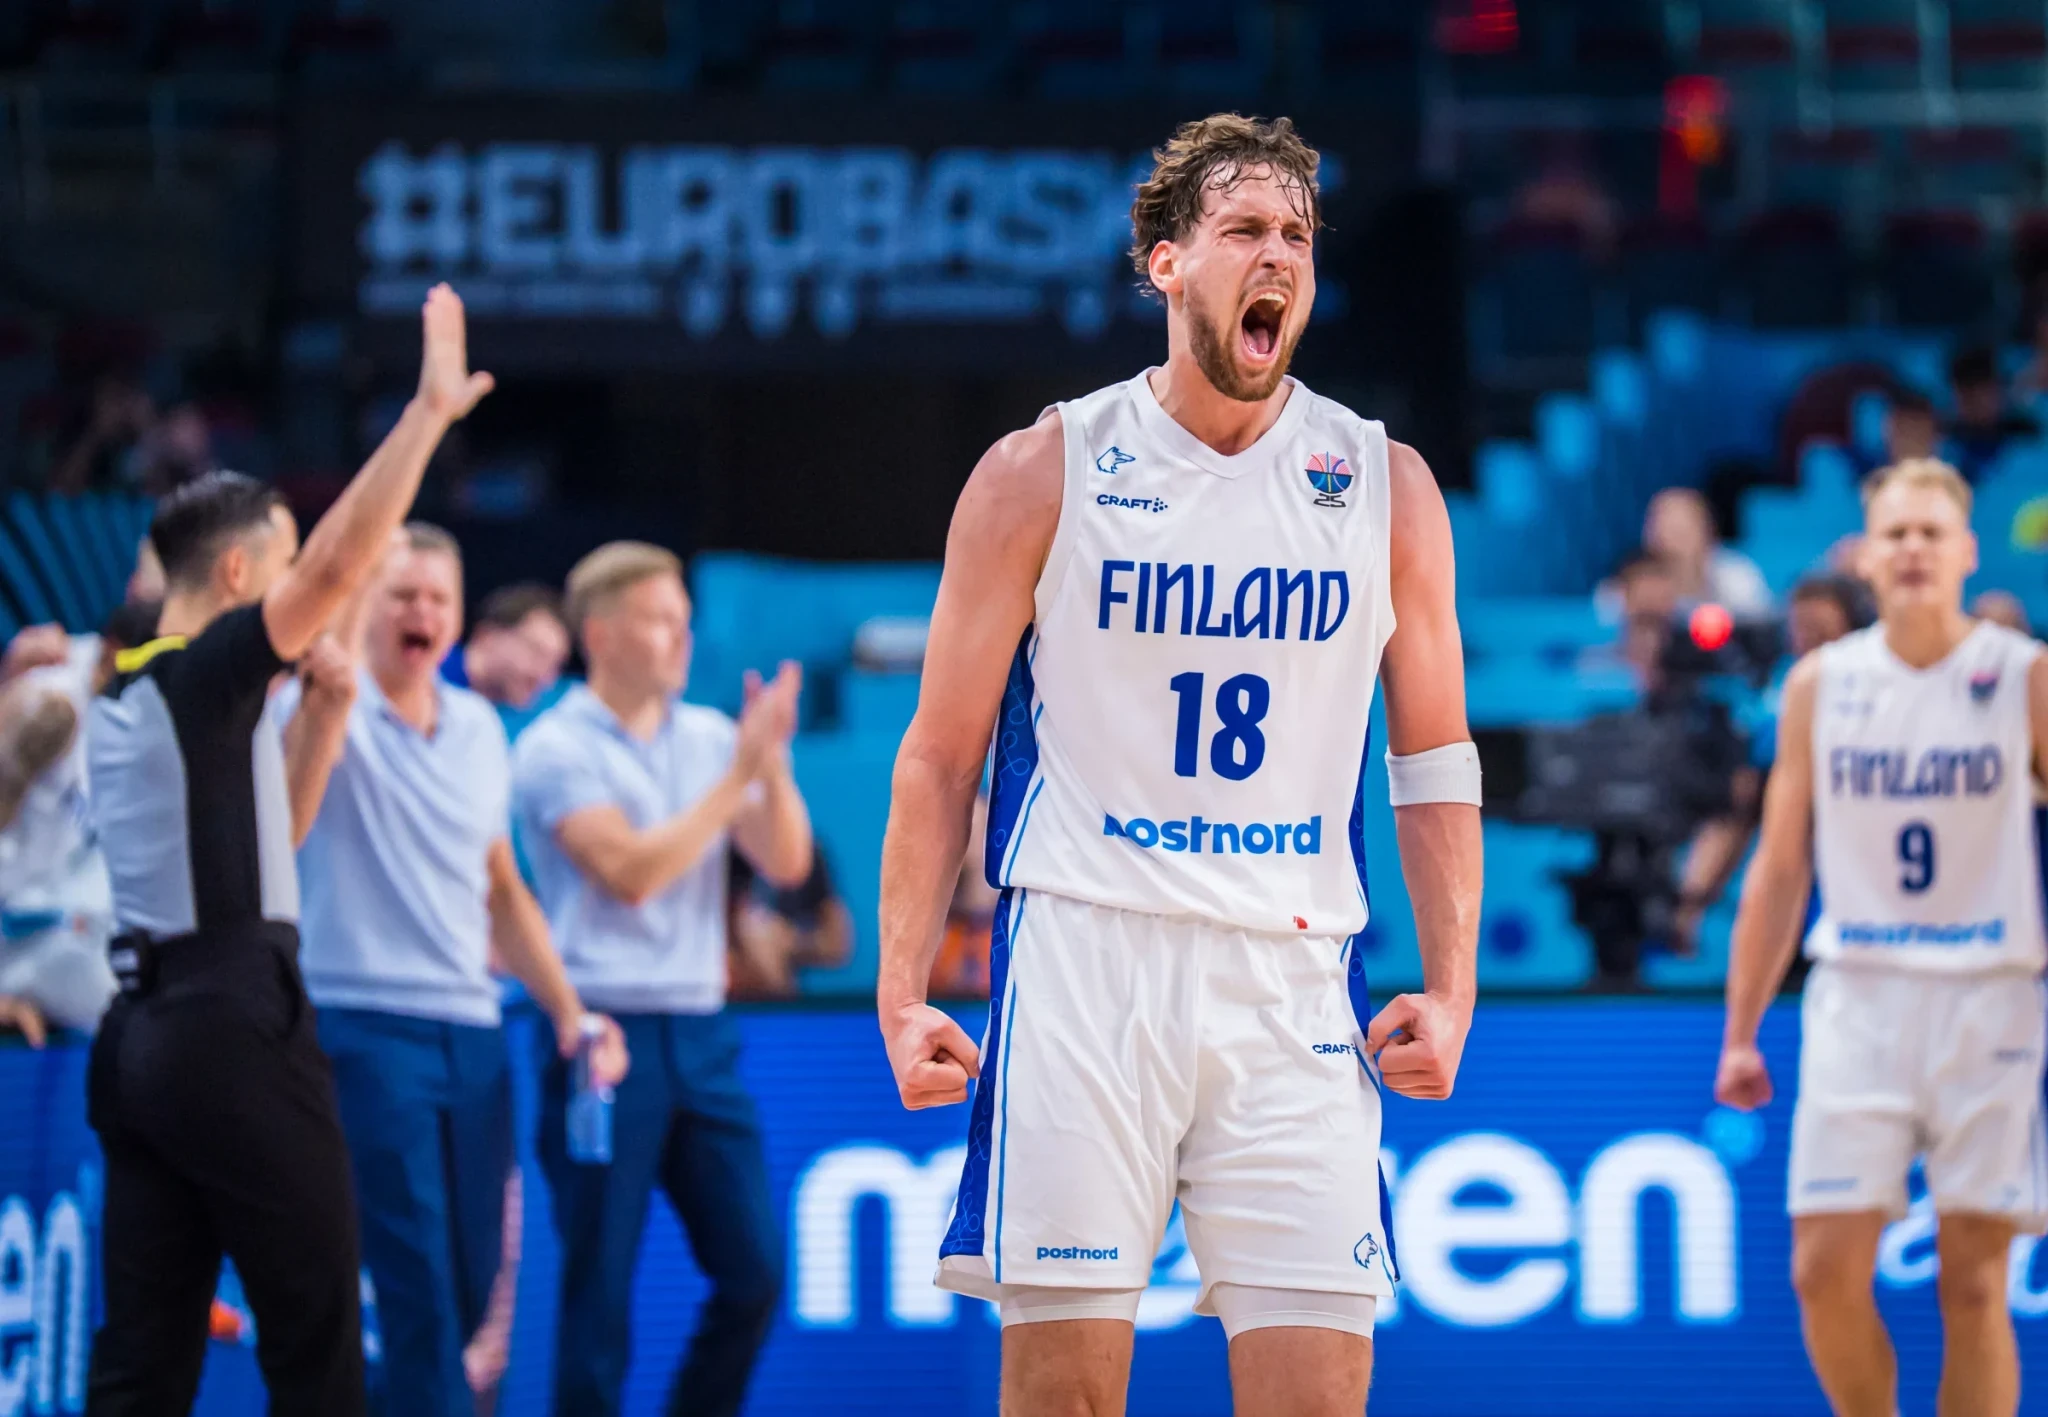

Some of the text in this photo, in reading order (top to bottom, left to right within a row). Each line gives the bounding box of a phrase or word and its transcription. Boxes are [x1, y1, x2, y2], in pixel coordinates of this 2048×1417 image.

[361, 143, 1343, 263] #EUROBAS
[1096, 494, 1152, 510] CRAFT
[1098, 560, 1350, 641] FINLAND
[1170, 672, 1270, 781] 18
[1897, 819, 1936, 894] 9
[1312, 1044, 1350, 1055] CRAFT
[1036, 1246, 1118, 1260] postnord
